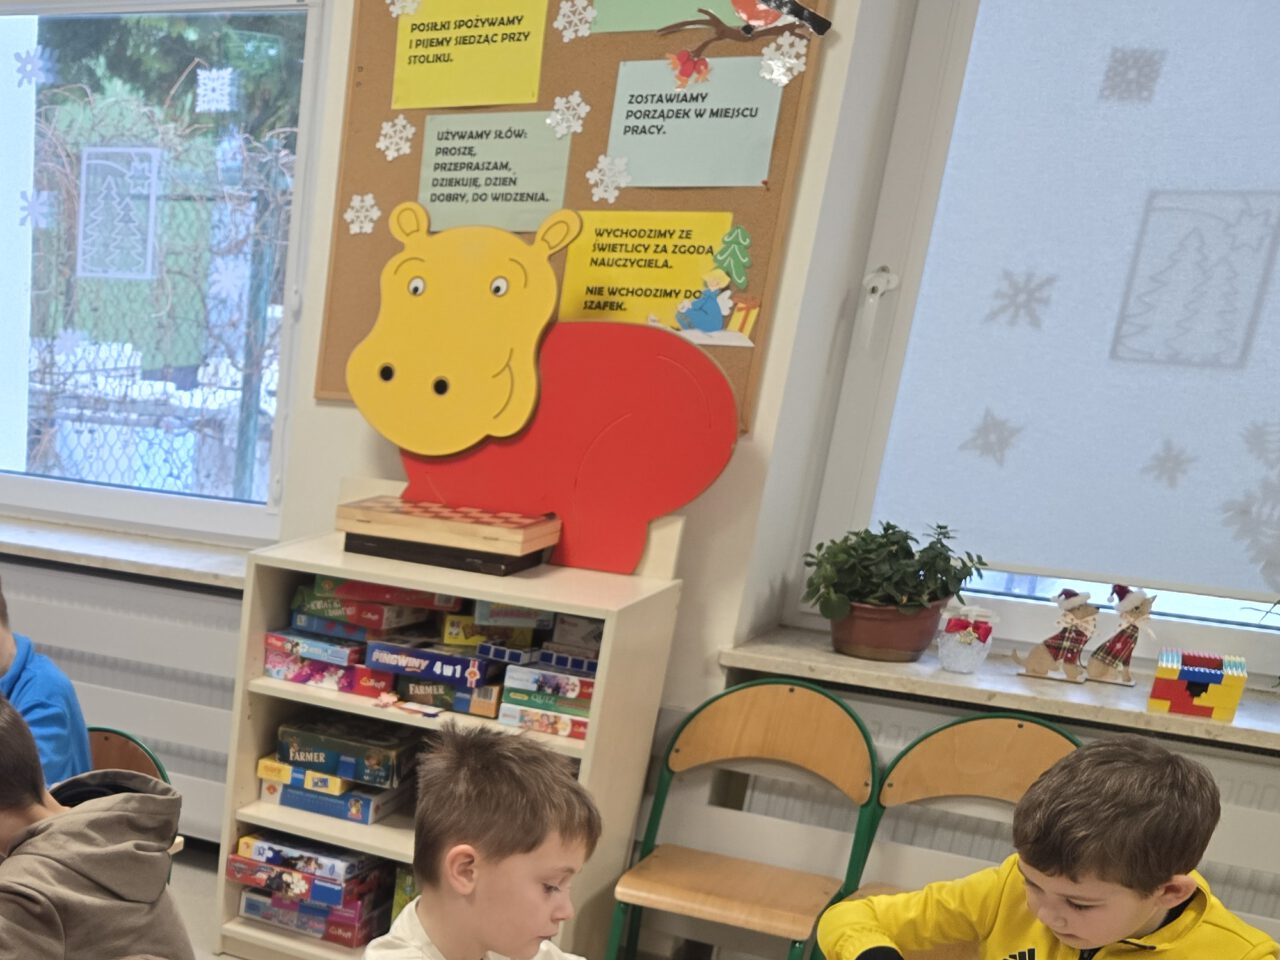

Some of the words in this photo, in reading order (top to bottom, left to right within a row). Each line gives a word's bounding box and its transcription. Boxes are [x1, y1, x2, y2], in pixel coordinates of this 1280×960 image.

[410, 20, 451, 33] POSIŁKI
[453, 15, 524, 30] SPOŻYWAMY
[415, 37, 452, 49] PIJEMY
[454, 33, 498, 46] SIEDZĄC
[501, 31, 530, 43] PRZY
[408, 53, 453, 65] STOLIKU.
[628, 93, 708, 104] ZOSTAWIAMY
[625, 108, 691, 121] PORZĄDEK
[694, 108, 706, 119] W
[708, 107, 759, 119] MIEJSCU
[437, 129, 491, 141] UŻYWAMY
[493, 126, 528, 139] SŁÓW:
[623, 124, 666, 135] PRACY.
[433, 161, 512, 172] PRZEPRASZAM,
[430, 192, 469, 203] DOBRY,
[471, 192, 488, 202] DO
[491, 192, 549, 202] WIDZENIA.
[594, 228, 676, 239] WYCHODZIMY
[678, 229, 693, 240] ZE
[653, 244, 668, 254] ZA
[590, 257, 673, 269] NAUCZYCIELA.
[585, 286, 604, 297] NIE
[607, 287, 681, 298] WCHODZIMY
[683, 289, 702, 300] DO
[583, 301, 627, 311] SZAFEK.
[372, 649, 430, 672] PINGWINY
[409, 684, 445, 695] FARMER
[289, 748, 326, 763] FARMER
